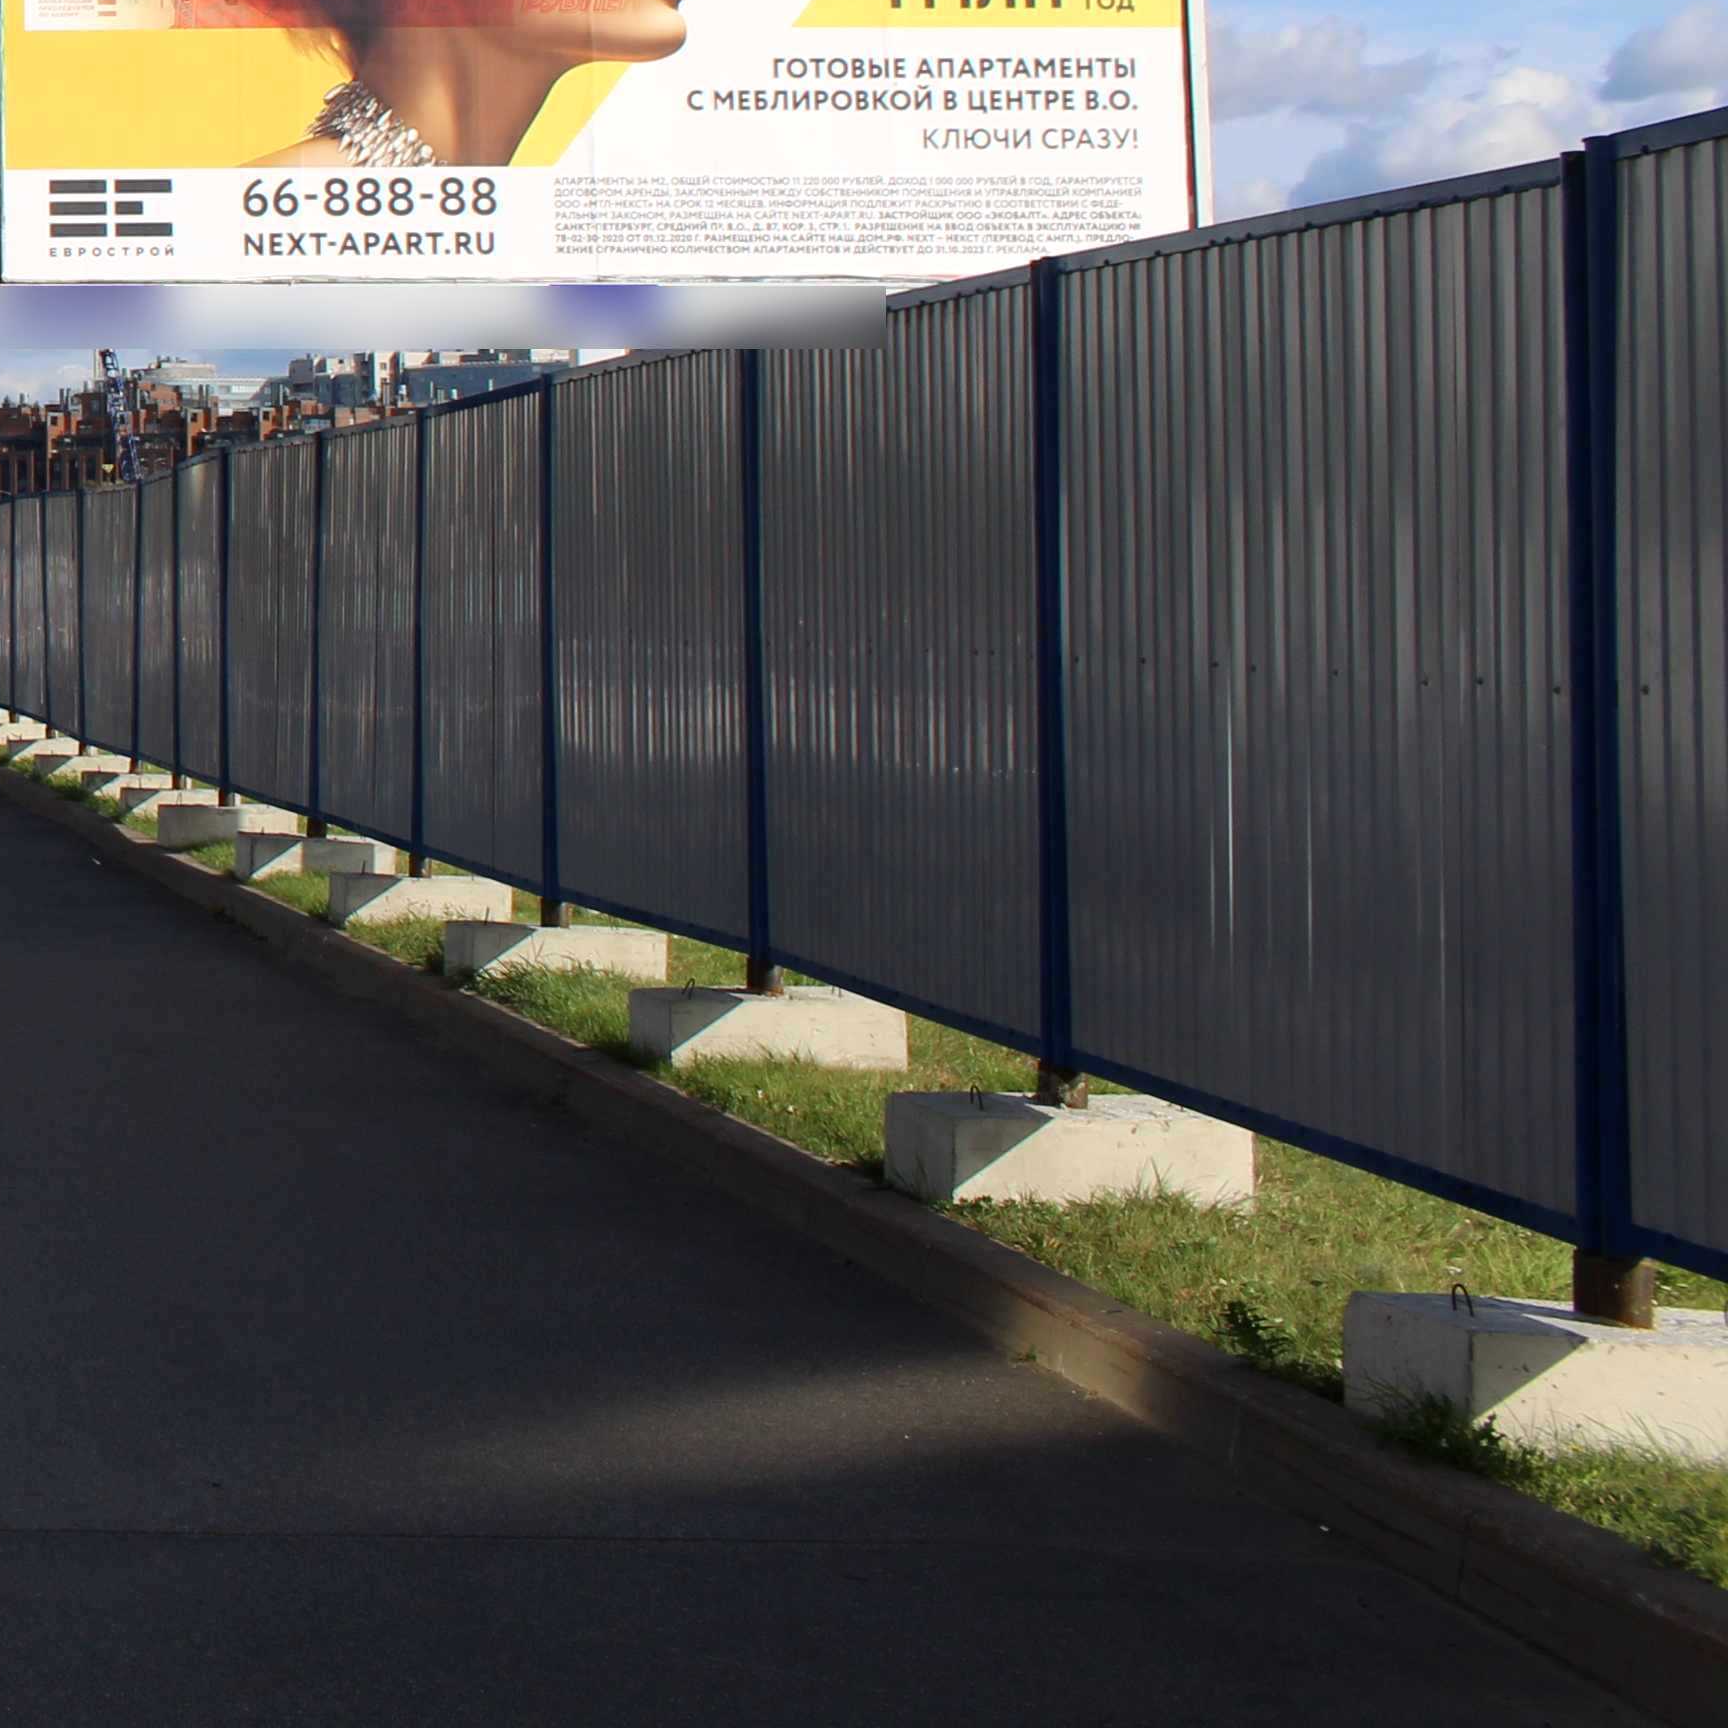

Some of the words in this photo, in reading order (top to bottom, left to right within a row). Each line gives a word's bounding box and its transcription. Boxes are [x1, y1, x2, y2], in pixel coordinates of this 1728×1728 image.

[772, 58, 908, 80] ГОТОВЫЕ
[917, 57, 1136, 80] АПАРТАМЕНТЫ
[687, 92, 704, 112] С
[713, 84, 934, 112] МЕБЛИРОВКОЙ
[943, 91, 958, 112] В
[967, 91, 1075, 115] ЦЕНТРЕ
[1085, 89, 1138, 112] В.О.
[922, 129, 1032, 151] КЛЮЧИ
[1042, 128, 1139, 150] СРАЗУ!
[242, 177, 498, 217] 66-888-88
[48, 242, 175, 258] ЕВРОСТРОЙ
[244, 231, 496, 257] NEXT-APART.RU
